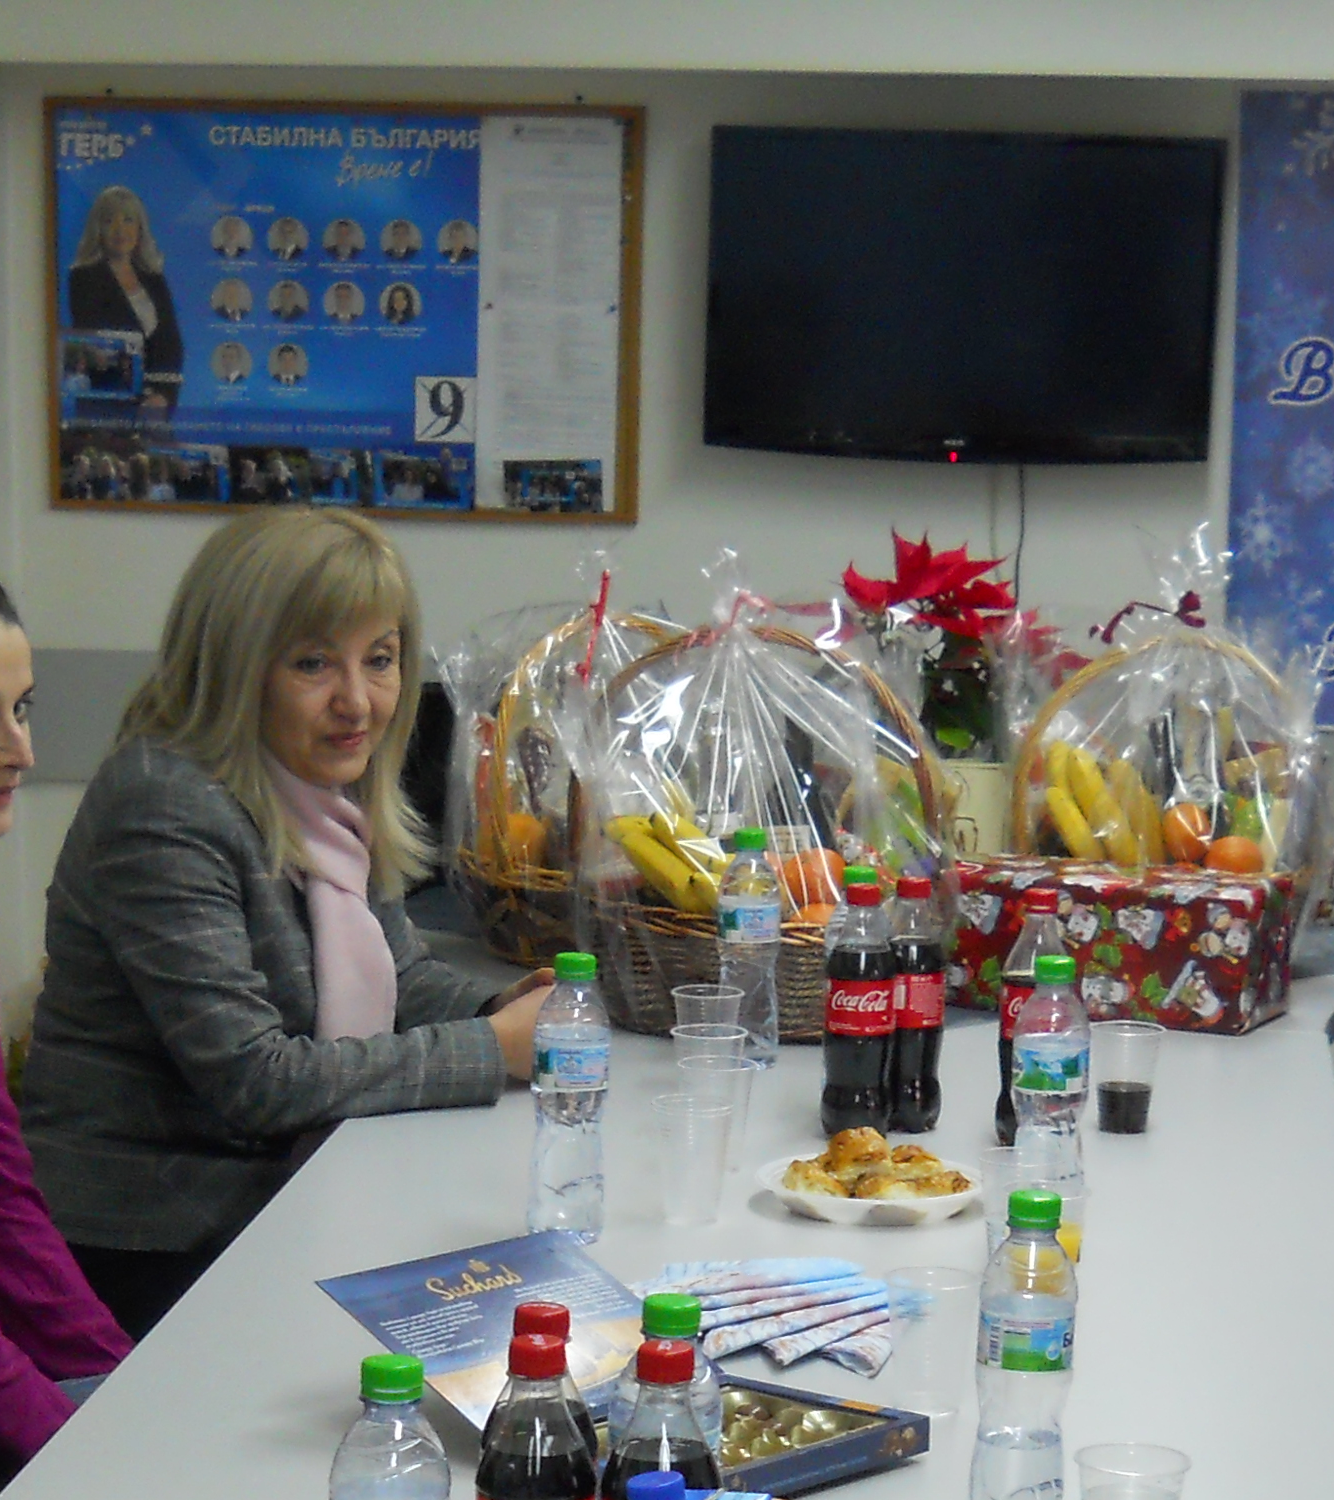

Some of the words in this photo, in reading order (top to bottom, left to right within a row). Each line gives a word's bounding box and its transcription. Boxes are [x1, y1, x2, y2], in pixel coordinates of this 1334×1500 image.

[59, 132, 124, 158] ГЕРБ
[208, 126, 343, 147] СТАБИЛНА
[351, 128, 481, 149] БЪЛГАРИЯ
[428, 380, 465, 438] 9
[831, 990, 890, 1012] Coca-Cola
[425, 1264, 523, 1301] Suchard
